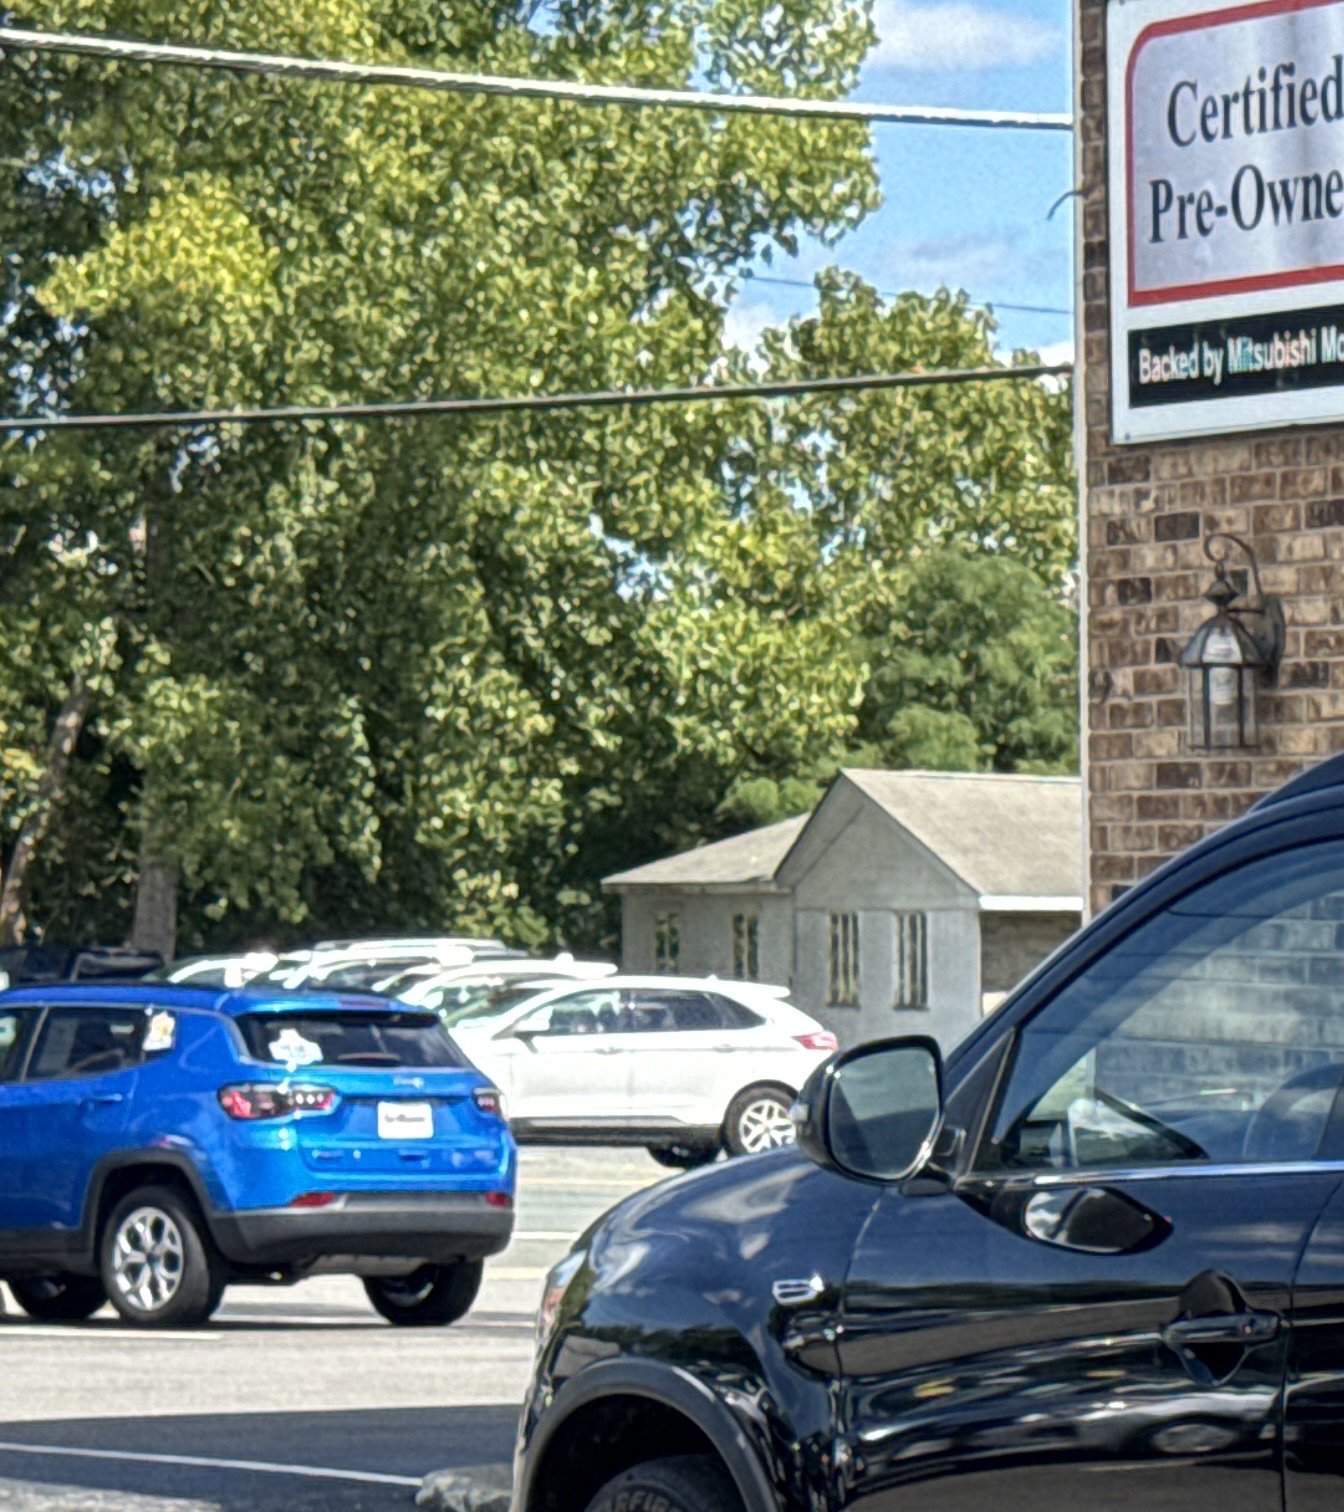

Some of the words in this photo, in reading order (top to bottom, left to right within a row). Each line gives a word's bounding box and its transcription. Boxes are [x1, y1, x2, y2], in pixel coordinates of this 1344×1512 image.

[1167, 53, 1344, 148] Certified
[1138, 341, 1199, 385] Backed
[1203, 340, 1224, 387] by
[1227, 328, 1317, 374] Mitsubishi
